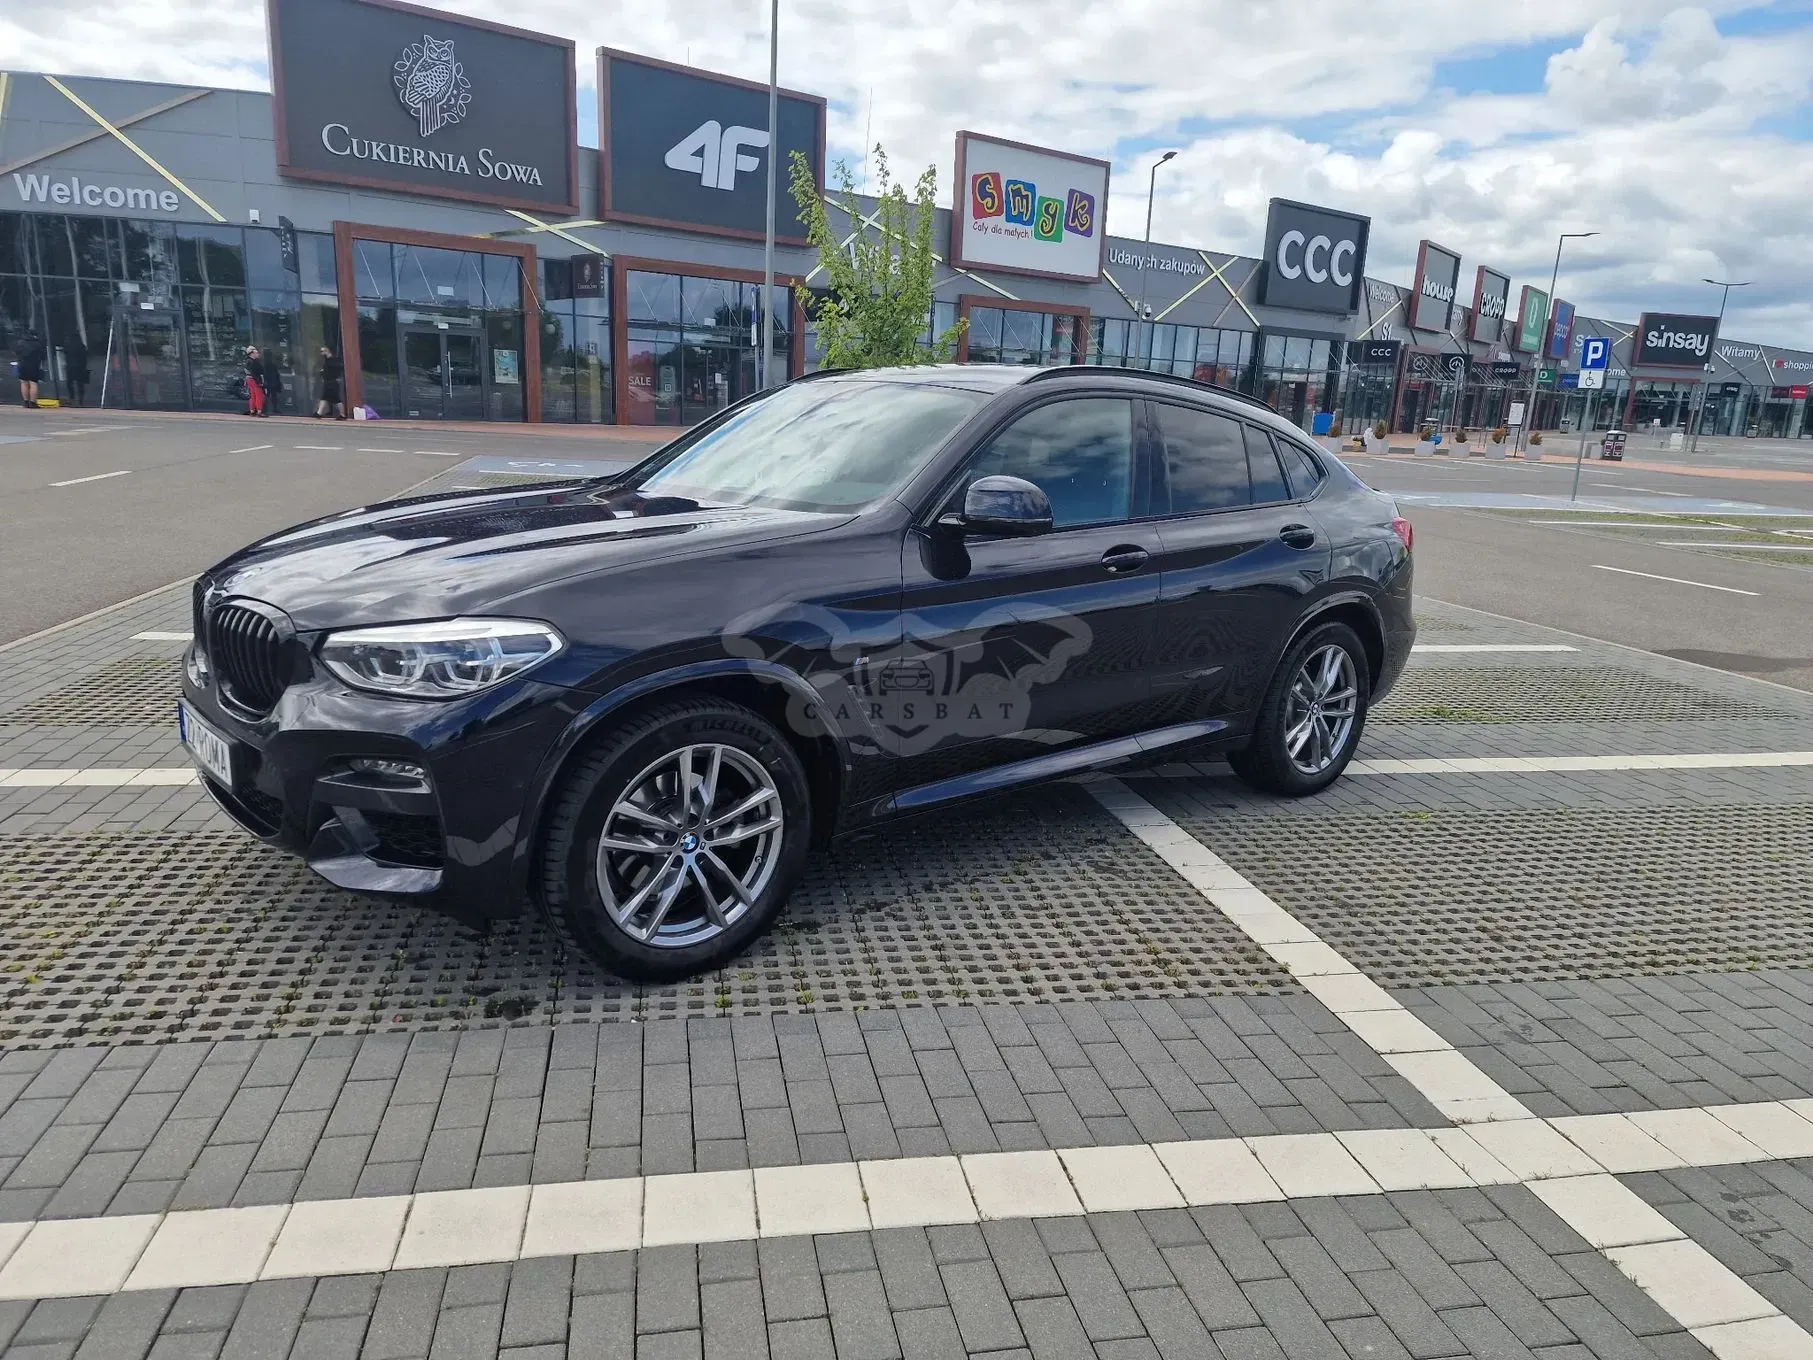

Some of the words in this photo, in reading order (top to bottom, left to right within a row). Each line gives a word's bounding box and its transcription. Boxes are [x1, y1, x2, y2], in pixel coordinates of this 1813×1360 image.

[321, 123, 471, 176] CUKIERNIA
[478, 148, 544, 186] SOWA
[665, 120, 770, 191] 4F
[12, 173, 179, 212] Welcome
[1160, 258, 1206, 276] zakupów
[1277, 229, 1356, 287] CCC
[1371, 348, 1392, 357] CCC
[1586, 341, 1604, 366] P
[1646, 325, 1709, 357] sinsay
[1721, 346, 1761, 361] Witamy
[628, 376, 652, 386] SALE
